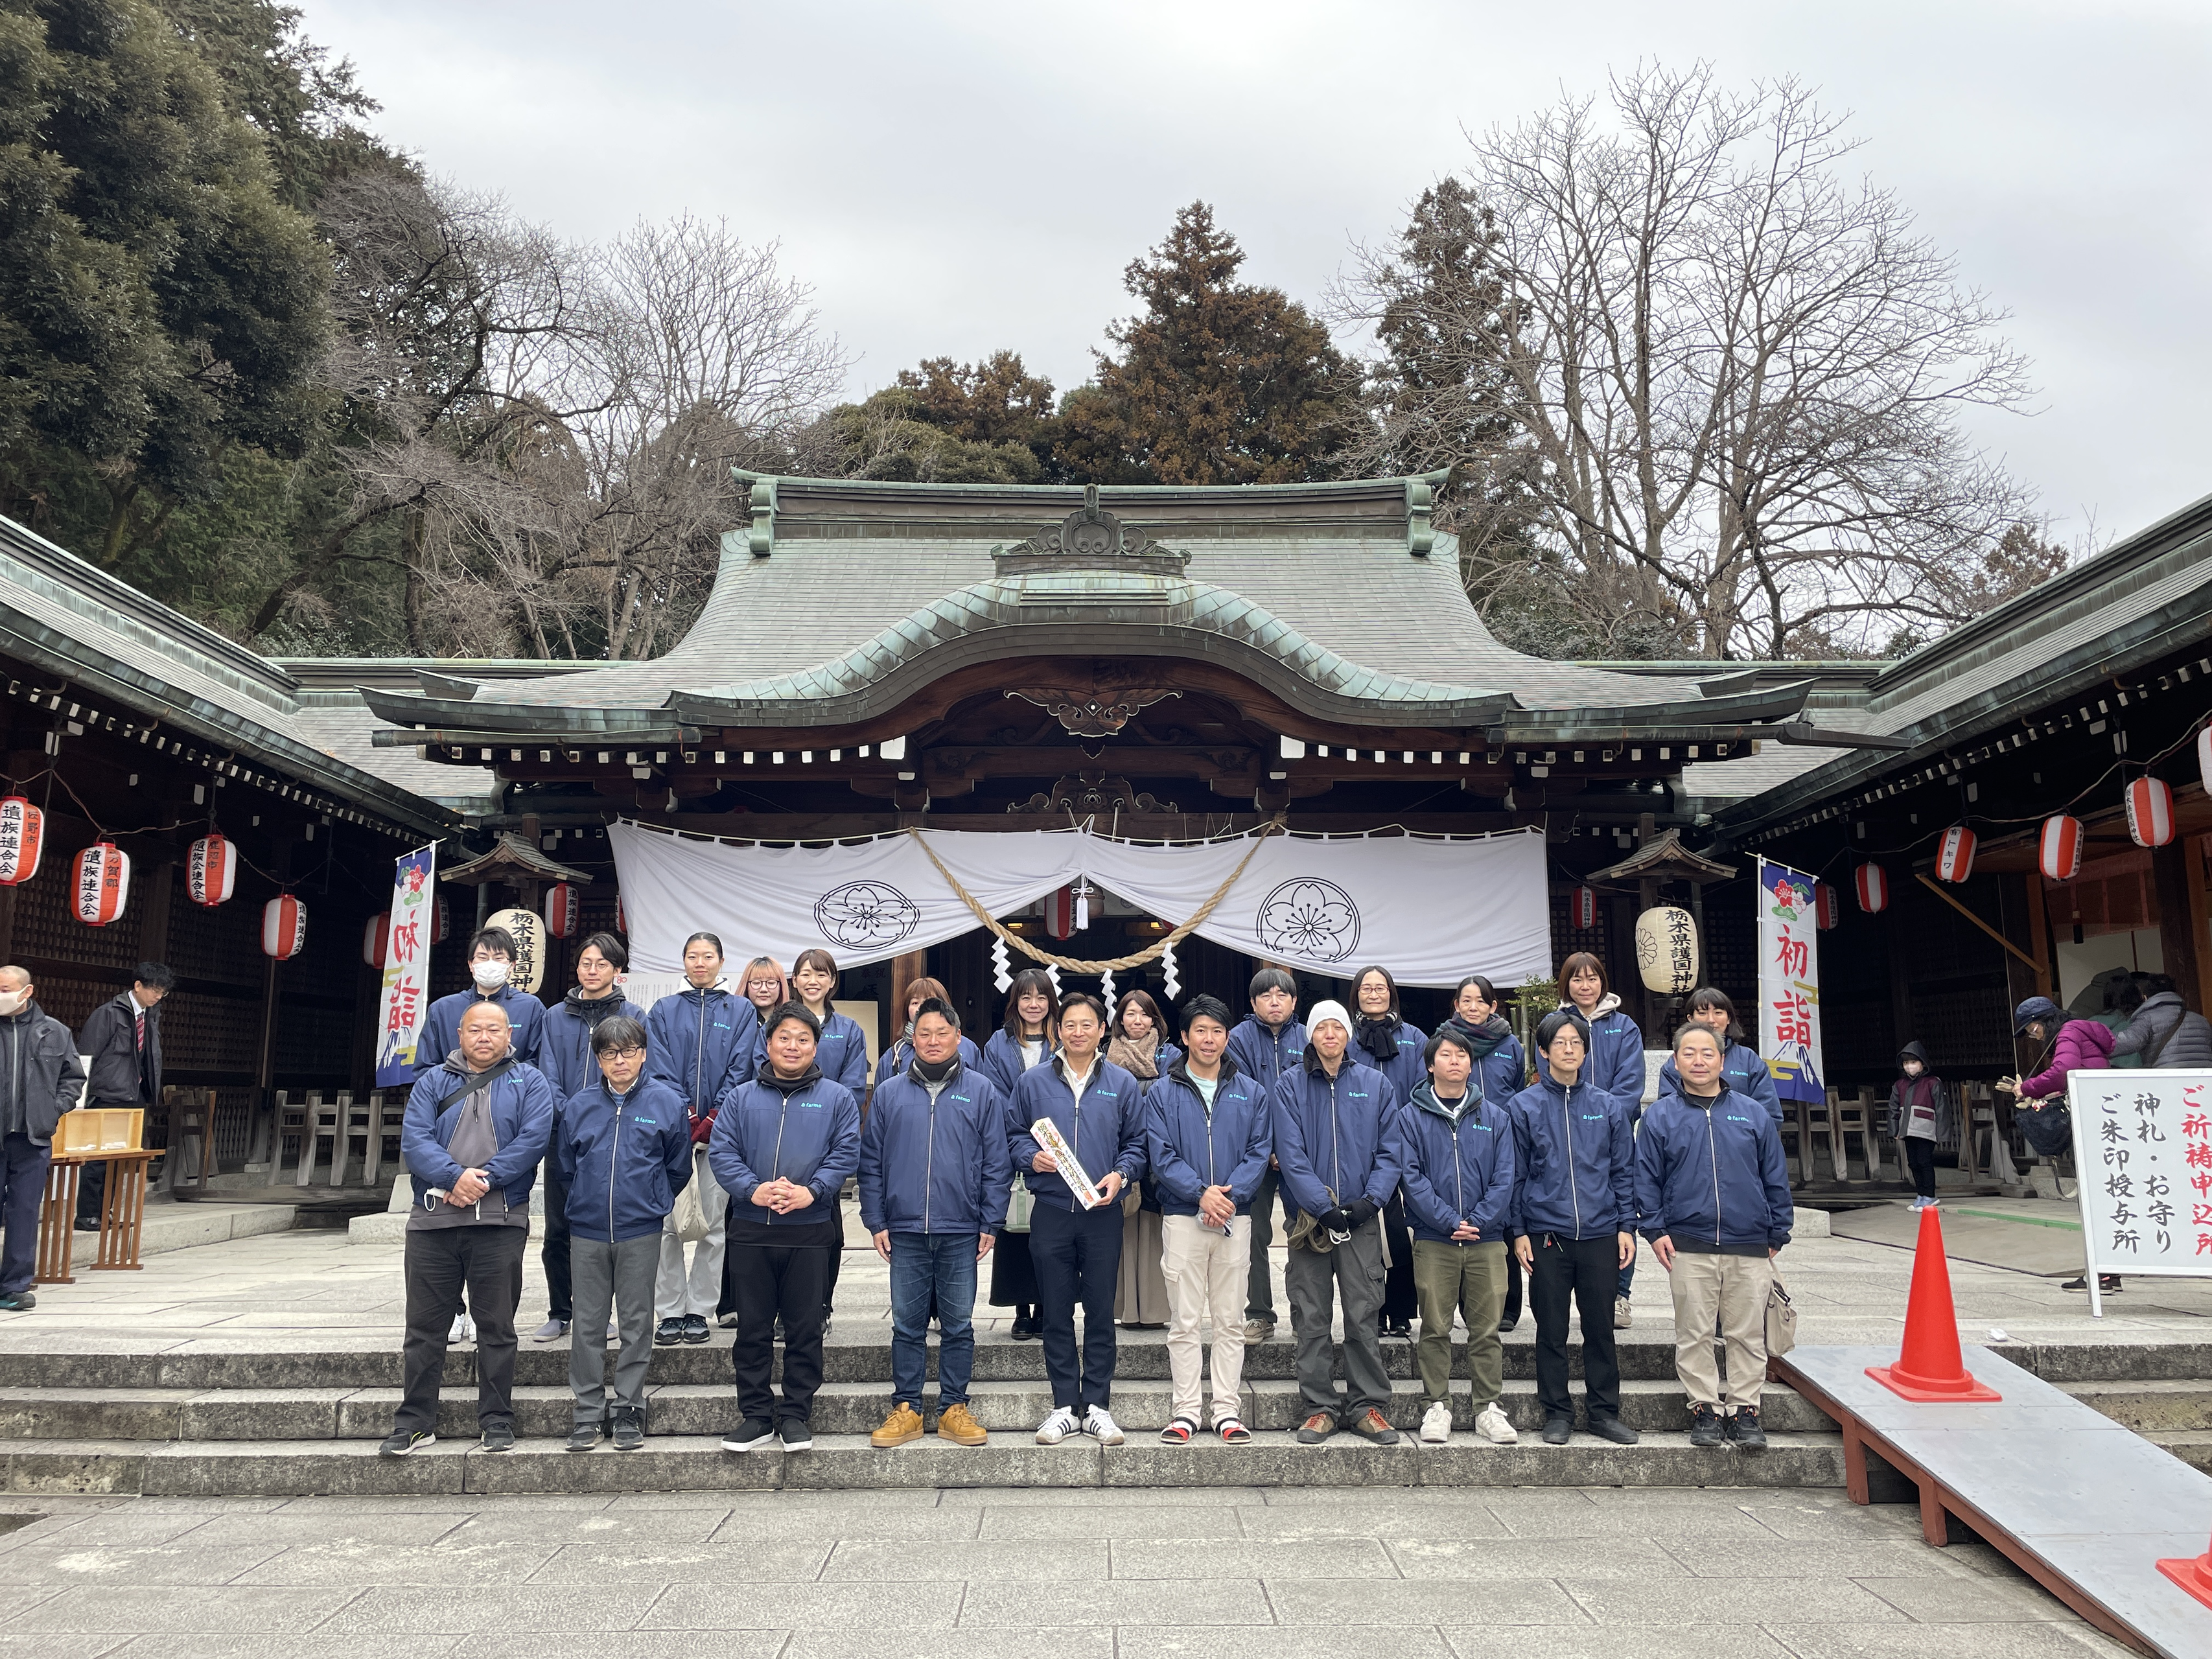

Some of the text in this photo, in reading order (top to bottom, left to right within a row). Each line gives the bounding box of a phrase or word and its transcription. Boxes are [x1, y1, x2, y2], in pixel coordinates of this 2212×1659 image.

[0, 806, 22, 874] 遺族連合会
[80, 850, 101, 916] 遺族連合会
[509, 912, 536, 993] 栃木県護国神
[1773, 923, 1811, 1050] 初詣
[640, 1116, 656, 1124] farmo
[2101, 1093, 2141, 1254] ご朱印授与所
[2133, 1092, 2175, 1254] 神札・お守り
